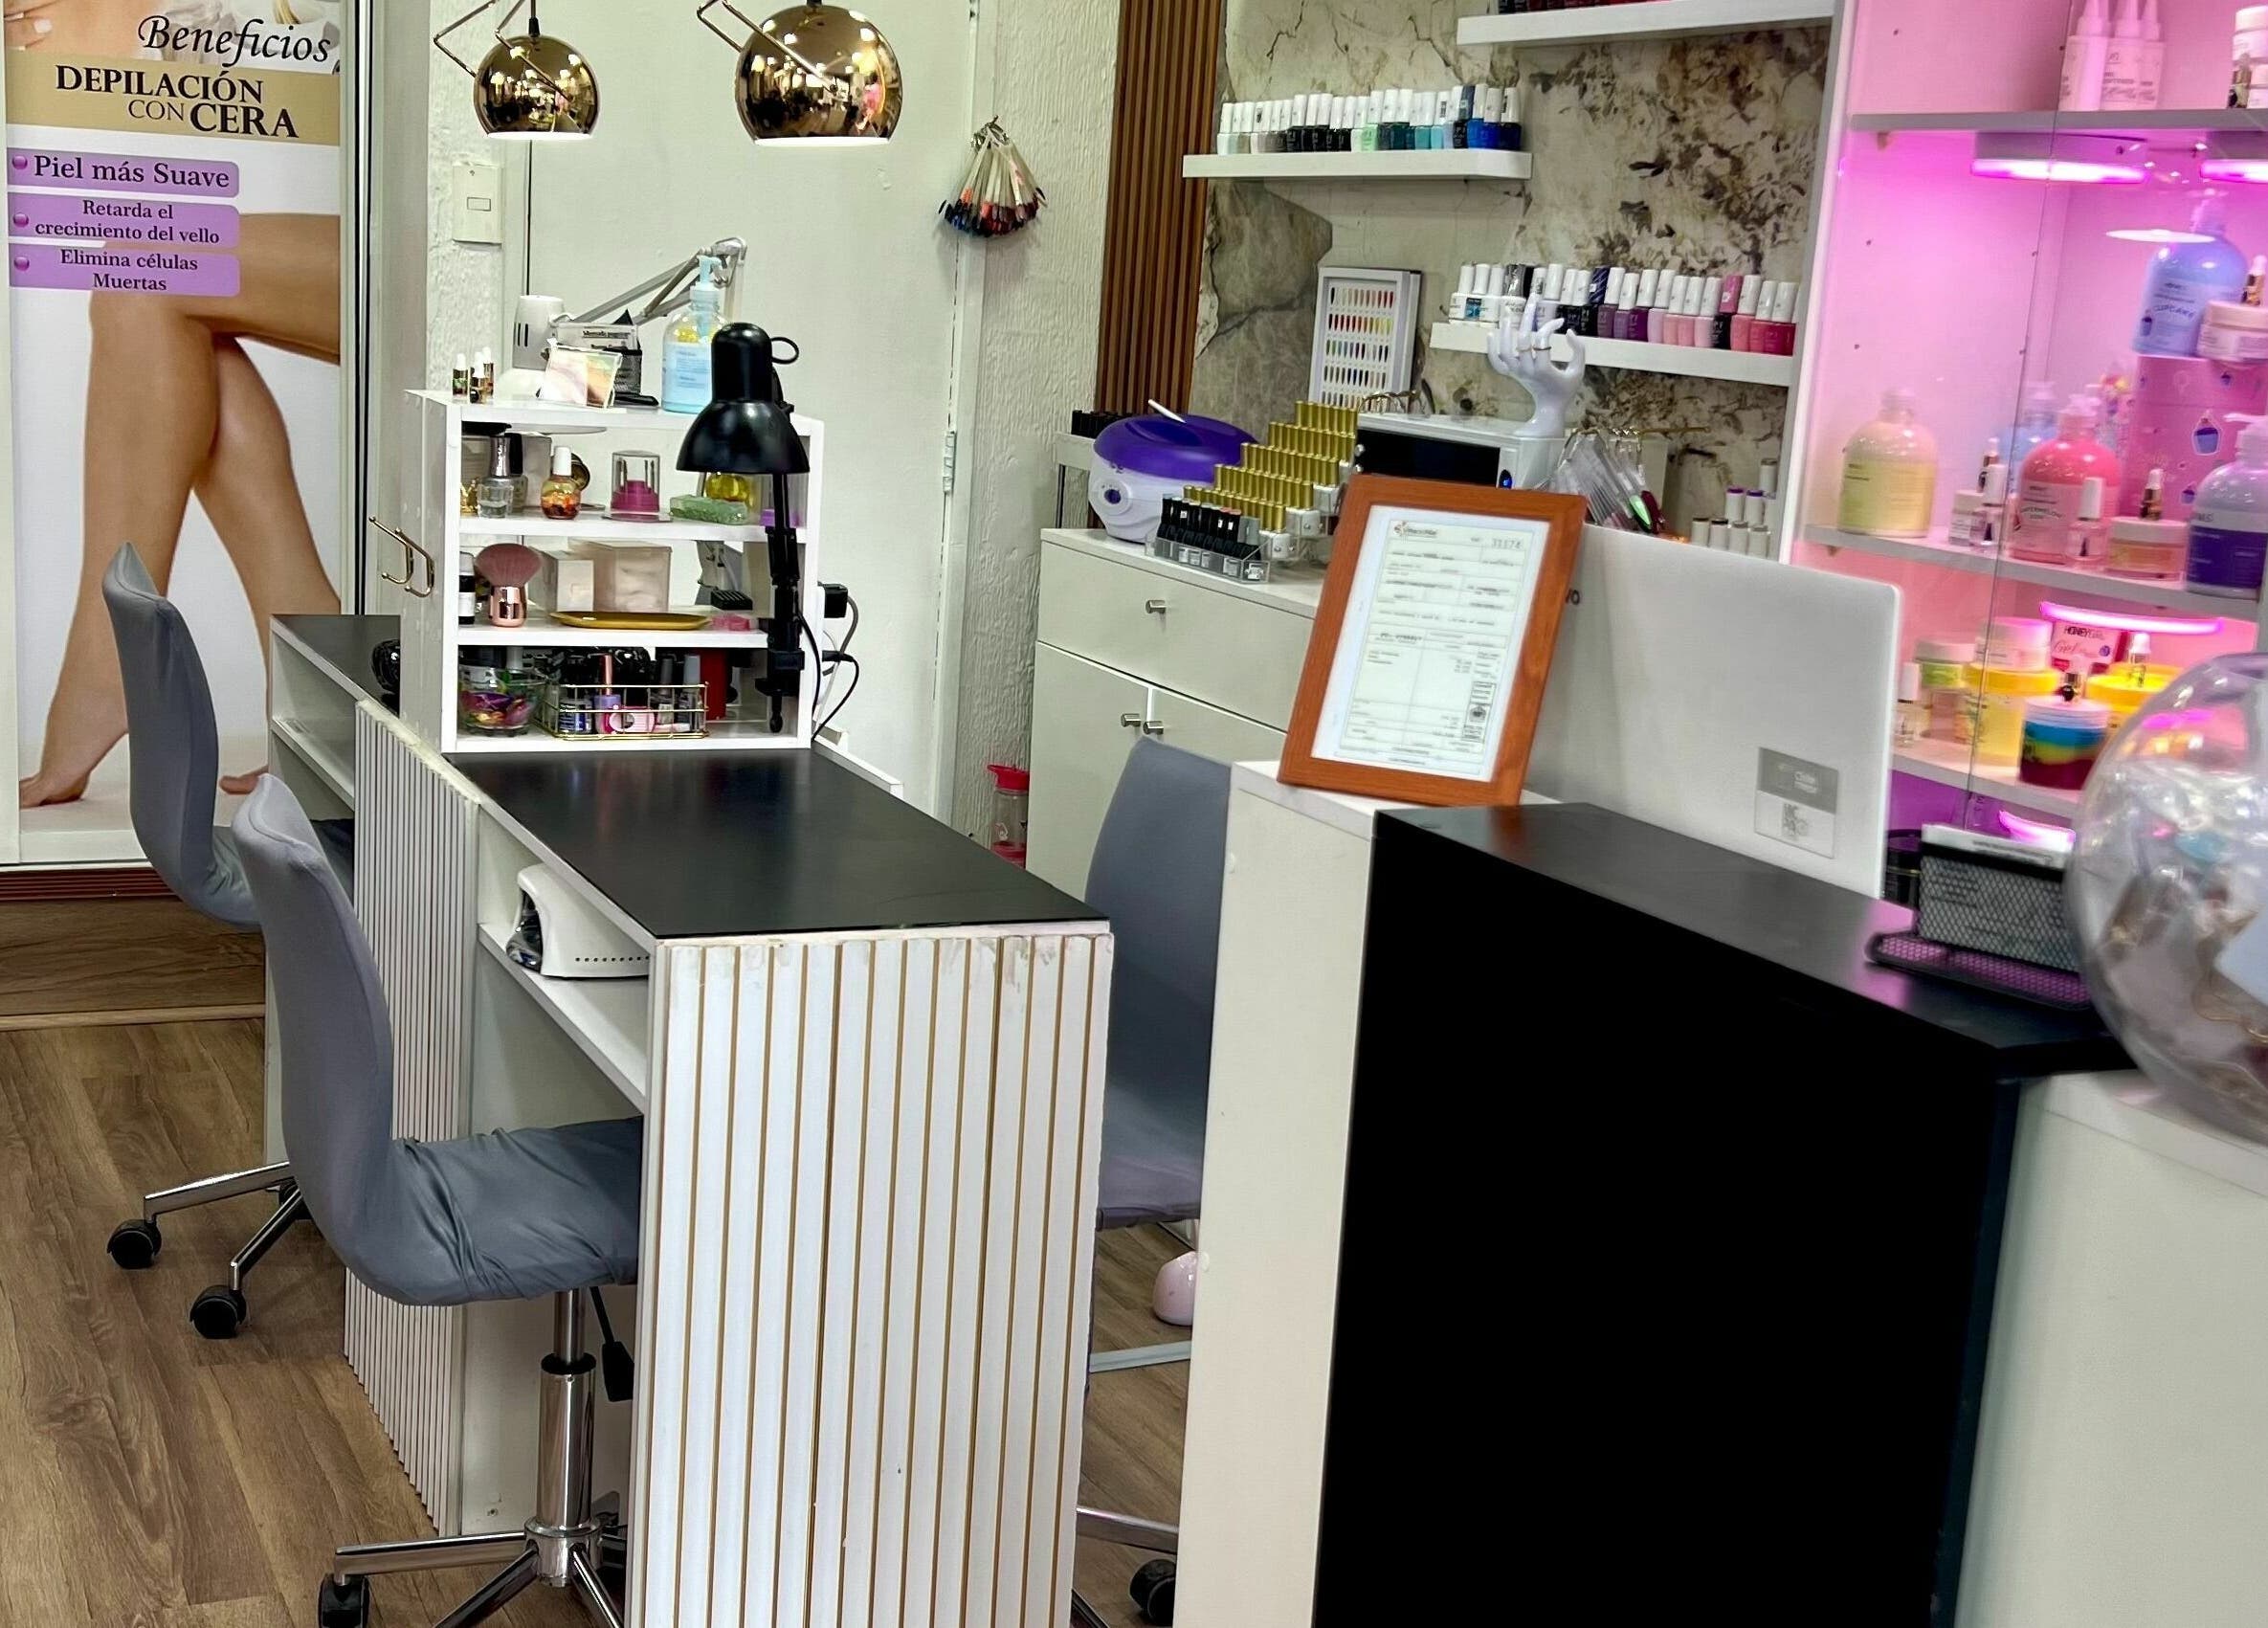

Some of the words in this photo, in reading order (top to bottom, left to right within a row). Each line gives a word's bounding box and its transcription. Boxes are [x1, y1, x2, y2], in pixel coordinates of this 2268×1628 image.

[139, 15, 331, 68] Beneficios
[56, 65, 264, 103] DEPILACIÓN
[128, 100, 185, 122] CON
[190, 103, 300, 139] CERA
[34, 155, 82, 180] Piel
[93, 162, 145, 183] más
[154, 164, 230, 189] Suave
[83, 200, 153, 219] Retarda
[158, 205, 173, 220] el
[35, 222, 142, 240] crecimiento
[147, 229, 174, 242] del
[180, 230, 220, 244] vello
[61, 250, 131, 267] Elimina
[137, 255, 198, 271] células
[94, 274, 167, 291] Muertas
